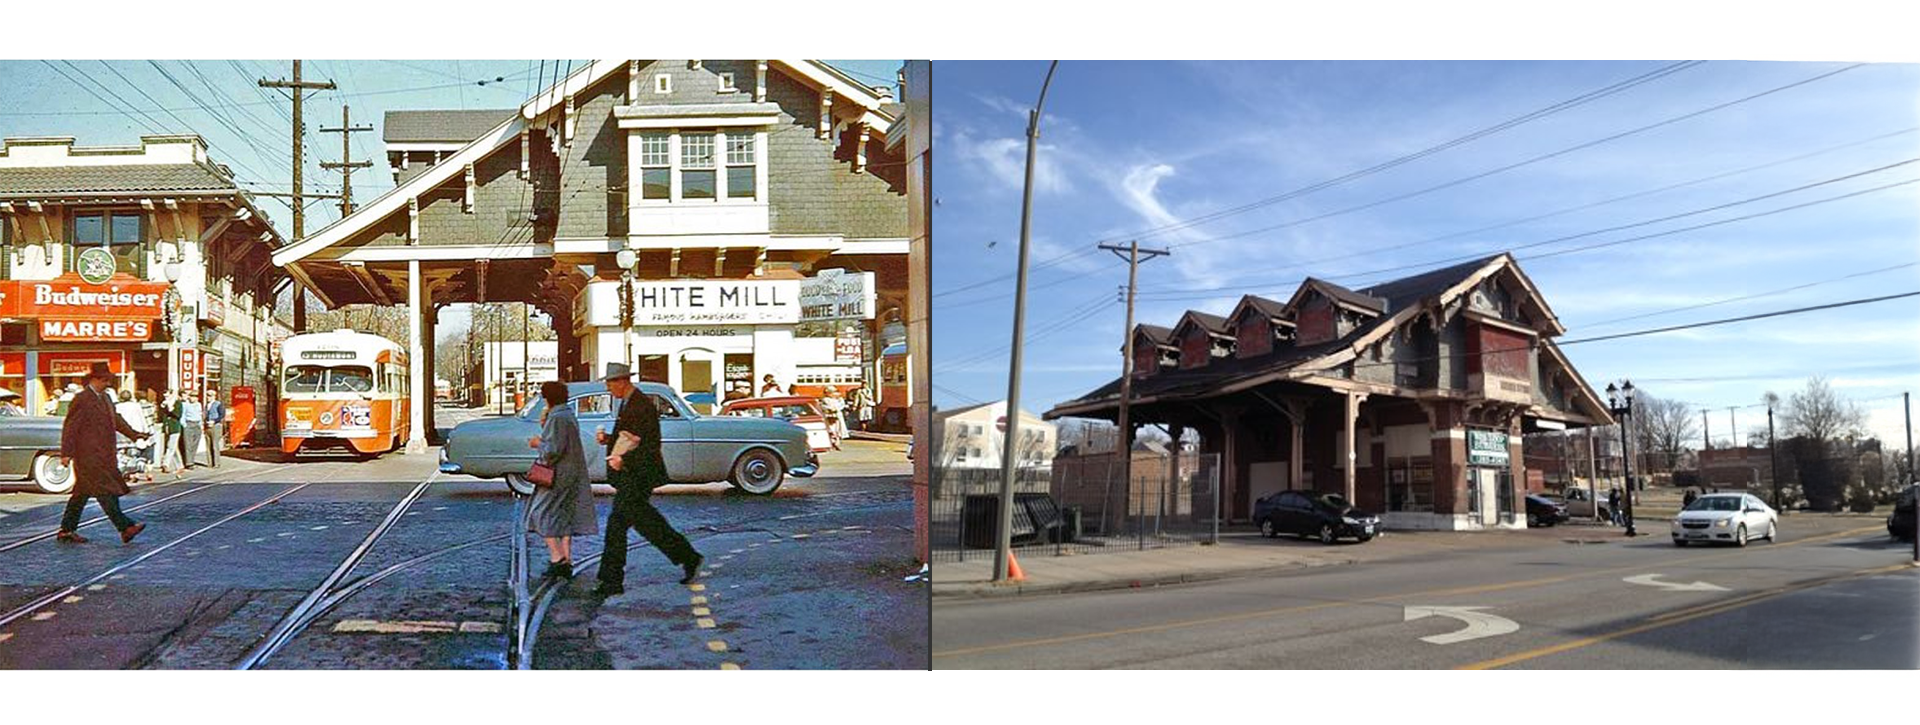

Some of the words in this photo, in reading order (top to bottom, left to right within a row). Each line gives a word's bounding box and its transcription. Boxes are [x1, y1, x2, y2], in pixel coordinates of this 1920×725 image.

[34, 284, 159, 307] Budweiser
[634, 286, 705, 308] HITE
[719, 286, 786, 307] MILL
[801, 303, 834, 318] WHITE
[838, 301, 864, 316] MILL
[43, 321, 148, 337] MARRE'S
[656, 329, 683, 337] OPEN
[686, 329, 698, 337] 24
[702, 329, 736, 337] HOURS
